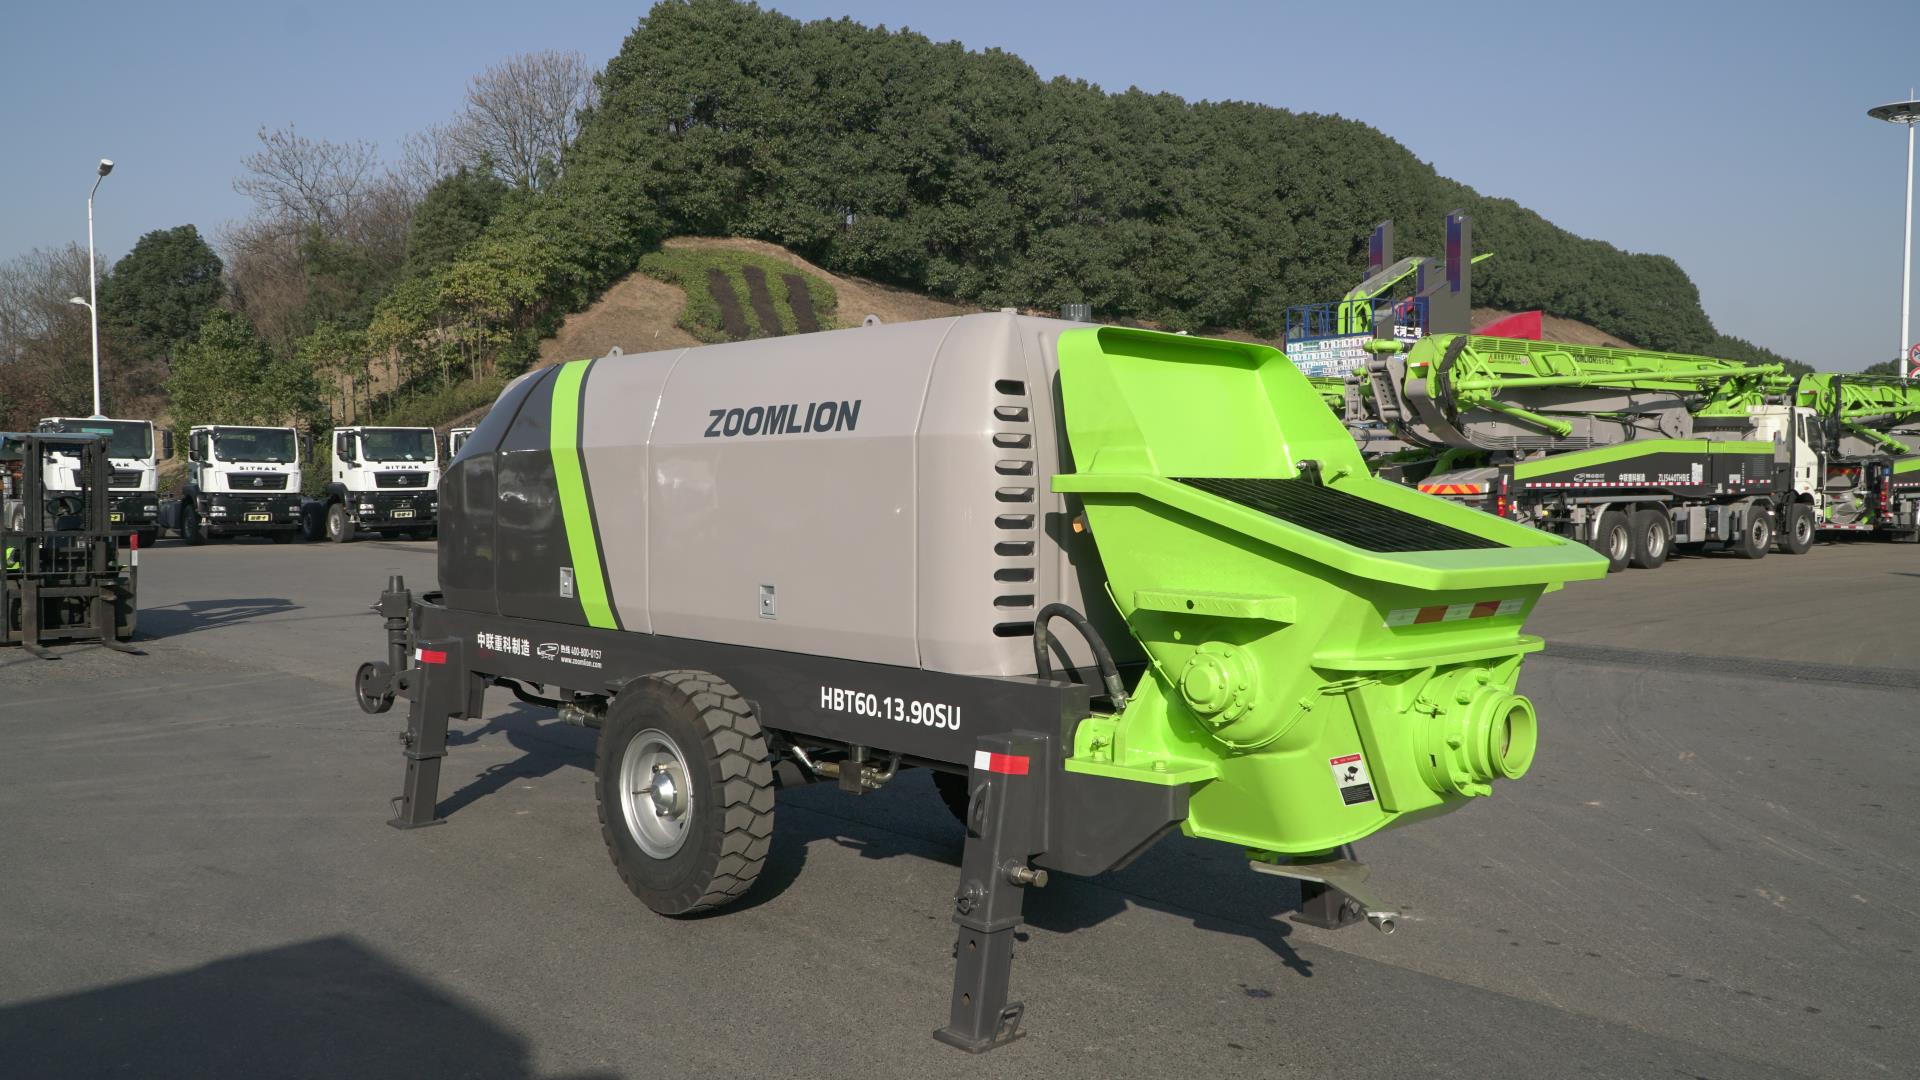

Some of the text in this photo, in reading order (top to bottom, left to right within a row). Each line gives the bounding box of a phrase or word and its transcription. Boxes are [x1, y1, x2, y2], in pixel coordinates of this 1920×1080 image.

[704, 400, 861, 437] ZOOMLION
[477, 631, 530, 657] 中联重科制造
[571, 646, 602, 659] 400-800-0157
[560, 656, 602, 669] www.zoomlion.com
[821, 686, 961, 730] HBT60.13.90SU
